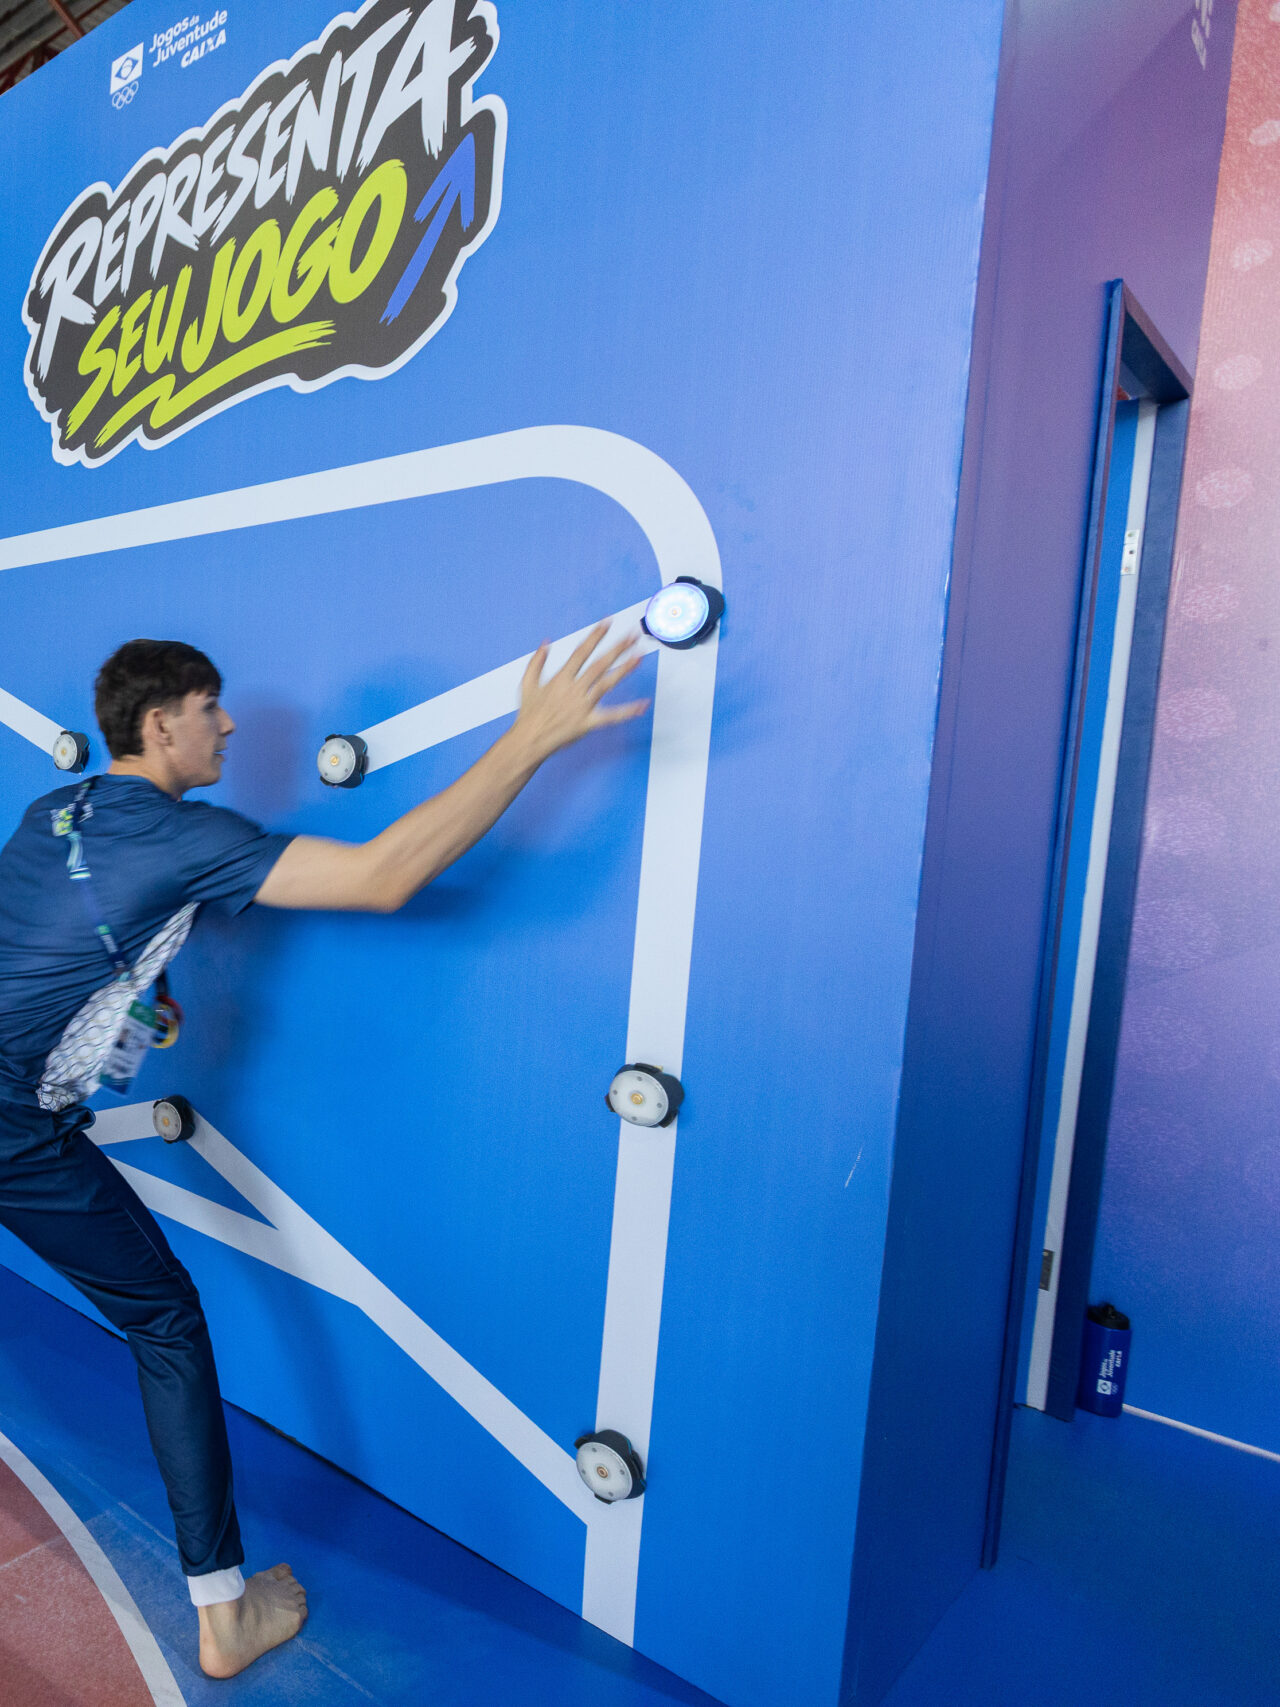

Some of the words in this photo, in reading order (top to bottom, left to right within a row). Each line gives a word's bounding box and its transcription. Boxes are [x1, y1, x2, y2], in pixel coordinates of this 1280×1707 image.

[149, 16, 190, 53] Jogos
[190, 15, 200, 28] da
[153, 10, 228, 68] Juventude
[181, 28, 227, 69] CAIXA
[38, 0, 476, 383] REPRESENTA
[65, 264, 193, 441] SEU
[181, 158, 409, 374] JOGO
